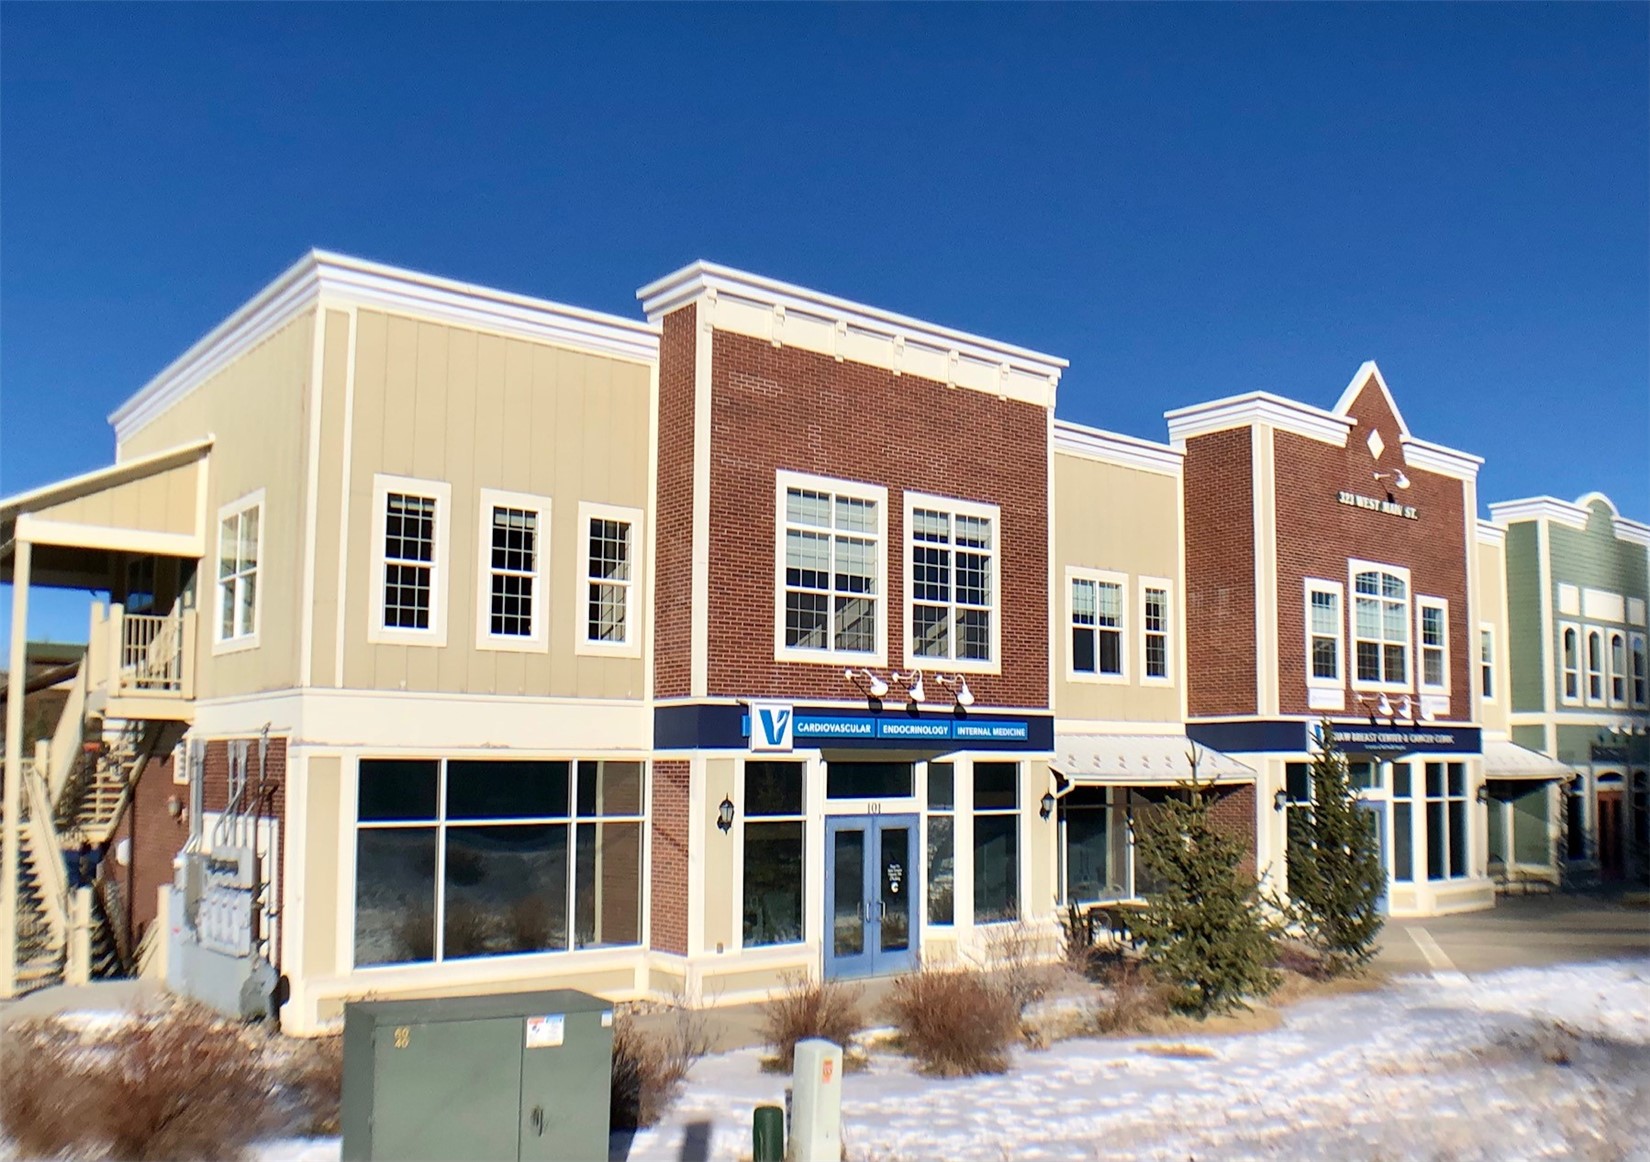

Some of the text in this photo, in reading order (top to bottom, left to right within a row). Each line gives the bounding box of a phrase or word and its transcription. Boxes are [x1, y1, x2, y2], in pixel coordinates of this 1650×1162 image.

[1355, 494, 1380, 511] WEST
[1381, 501, 1403, 516] MAIN
[1404, 506, 1418, 519] ST.
[797, 722, 871, 734] CARDIOVASCULAR
[883, 724, 949, 736] ENDOCRINOLOGY
[957, 726, 1026, 737] INTERNAL MEDICINE
[868, 803, 881, 814] 101
